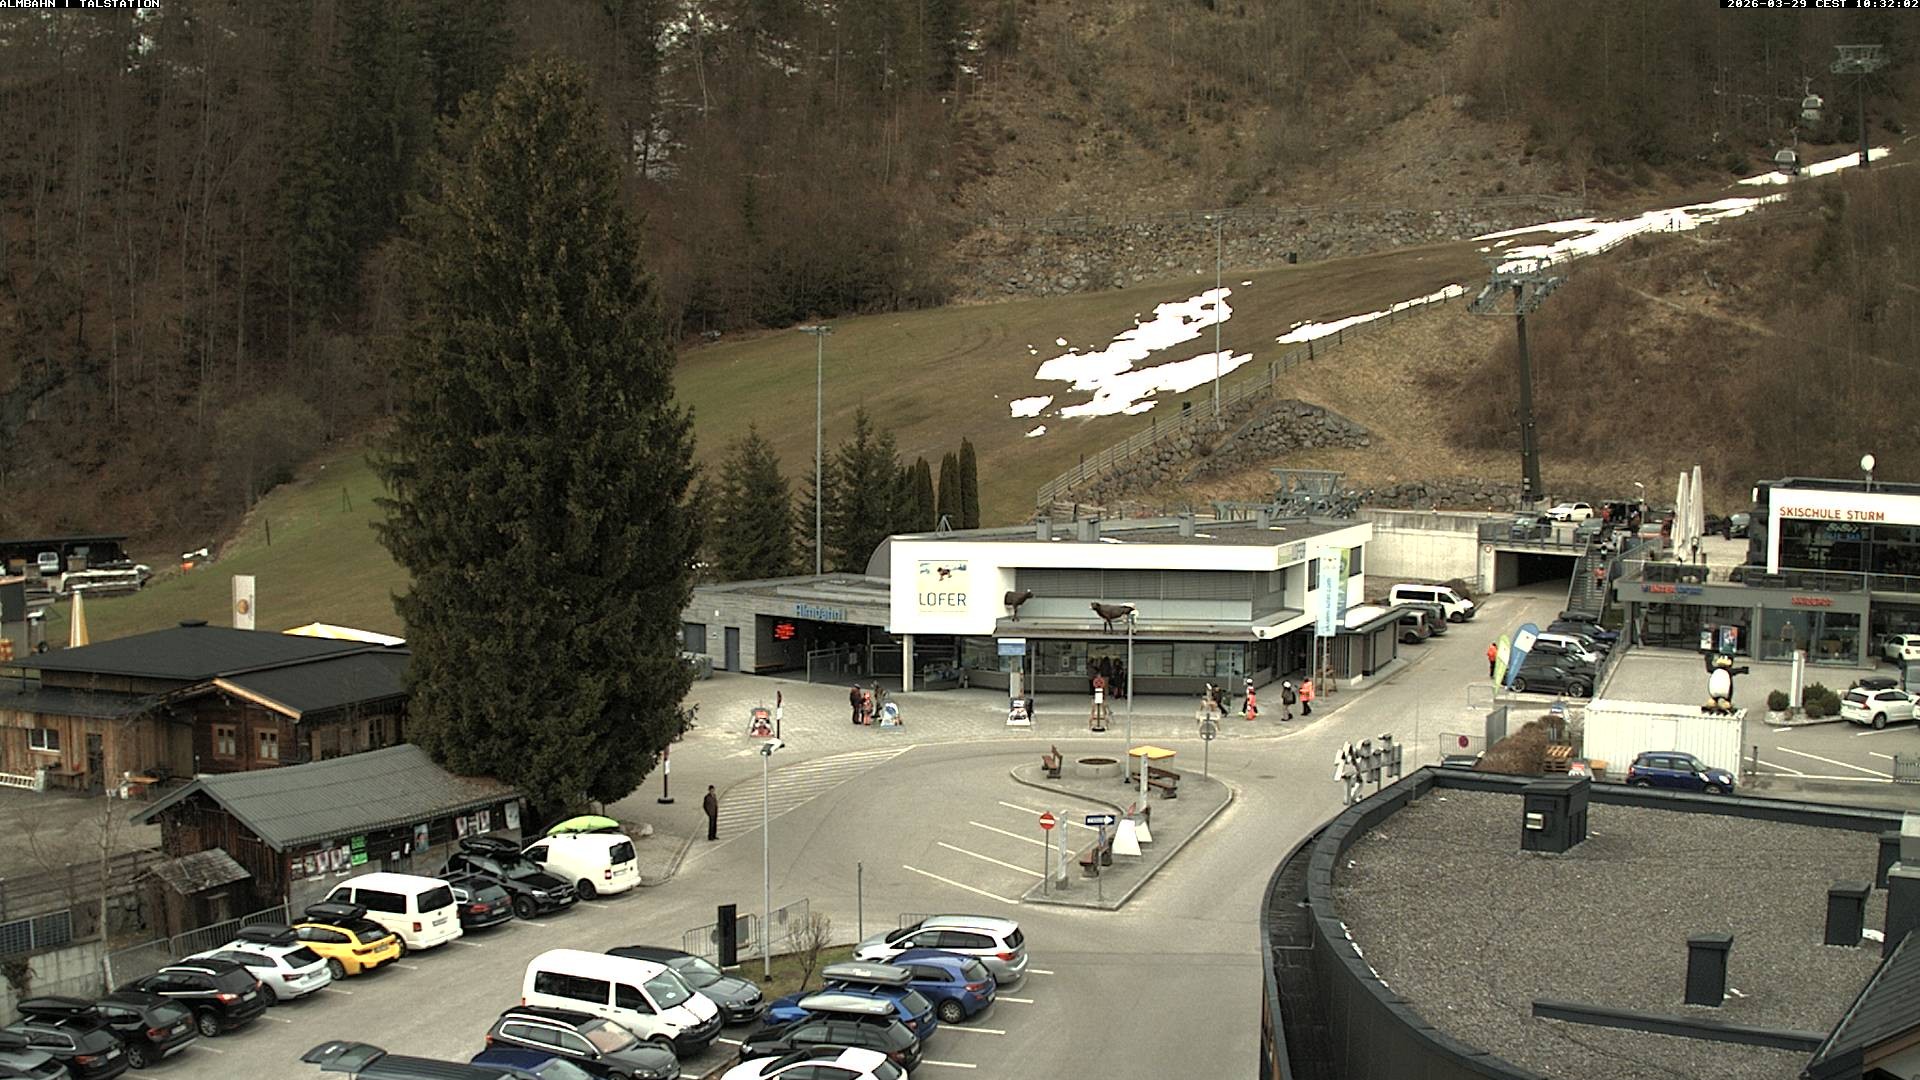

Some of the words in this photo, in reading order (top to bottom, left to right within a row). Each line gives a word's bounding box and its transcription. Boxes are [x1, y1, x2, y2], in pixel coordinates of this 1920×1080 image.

[1779, 506, 1841, 519] SKISCHULE
[1847, 510, 1885, 521] STURM
[919, 592, 967, 607] LOFER
